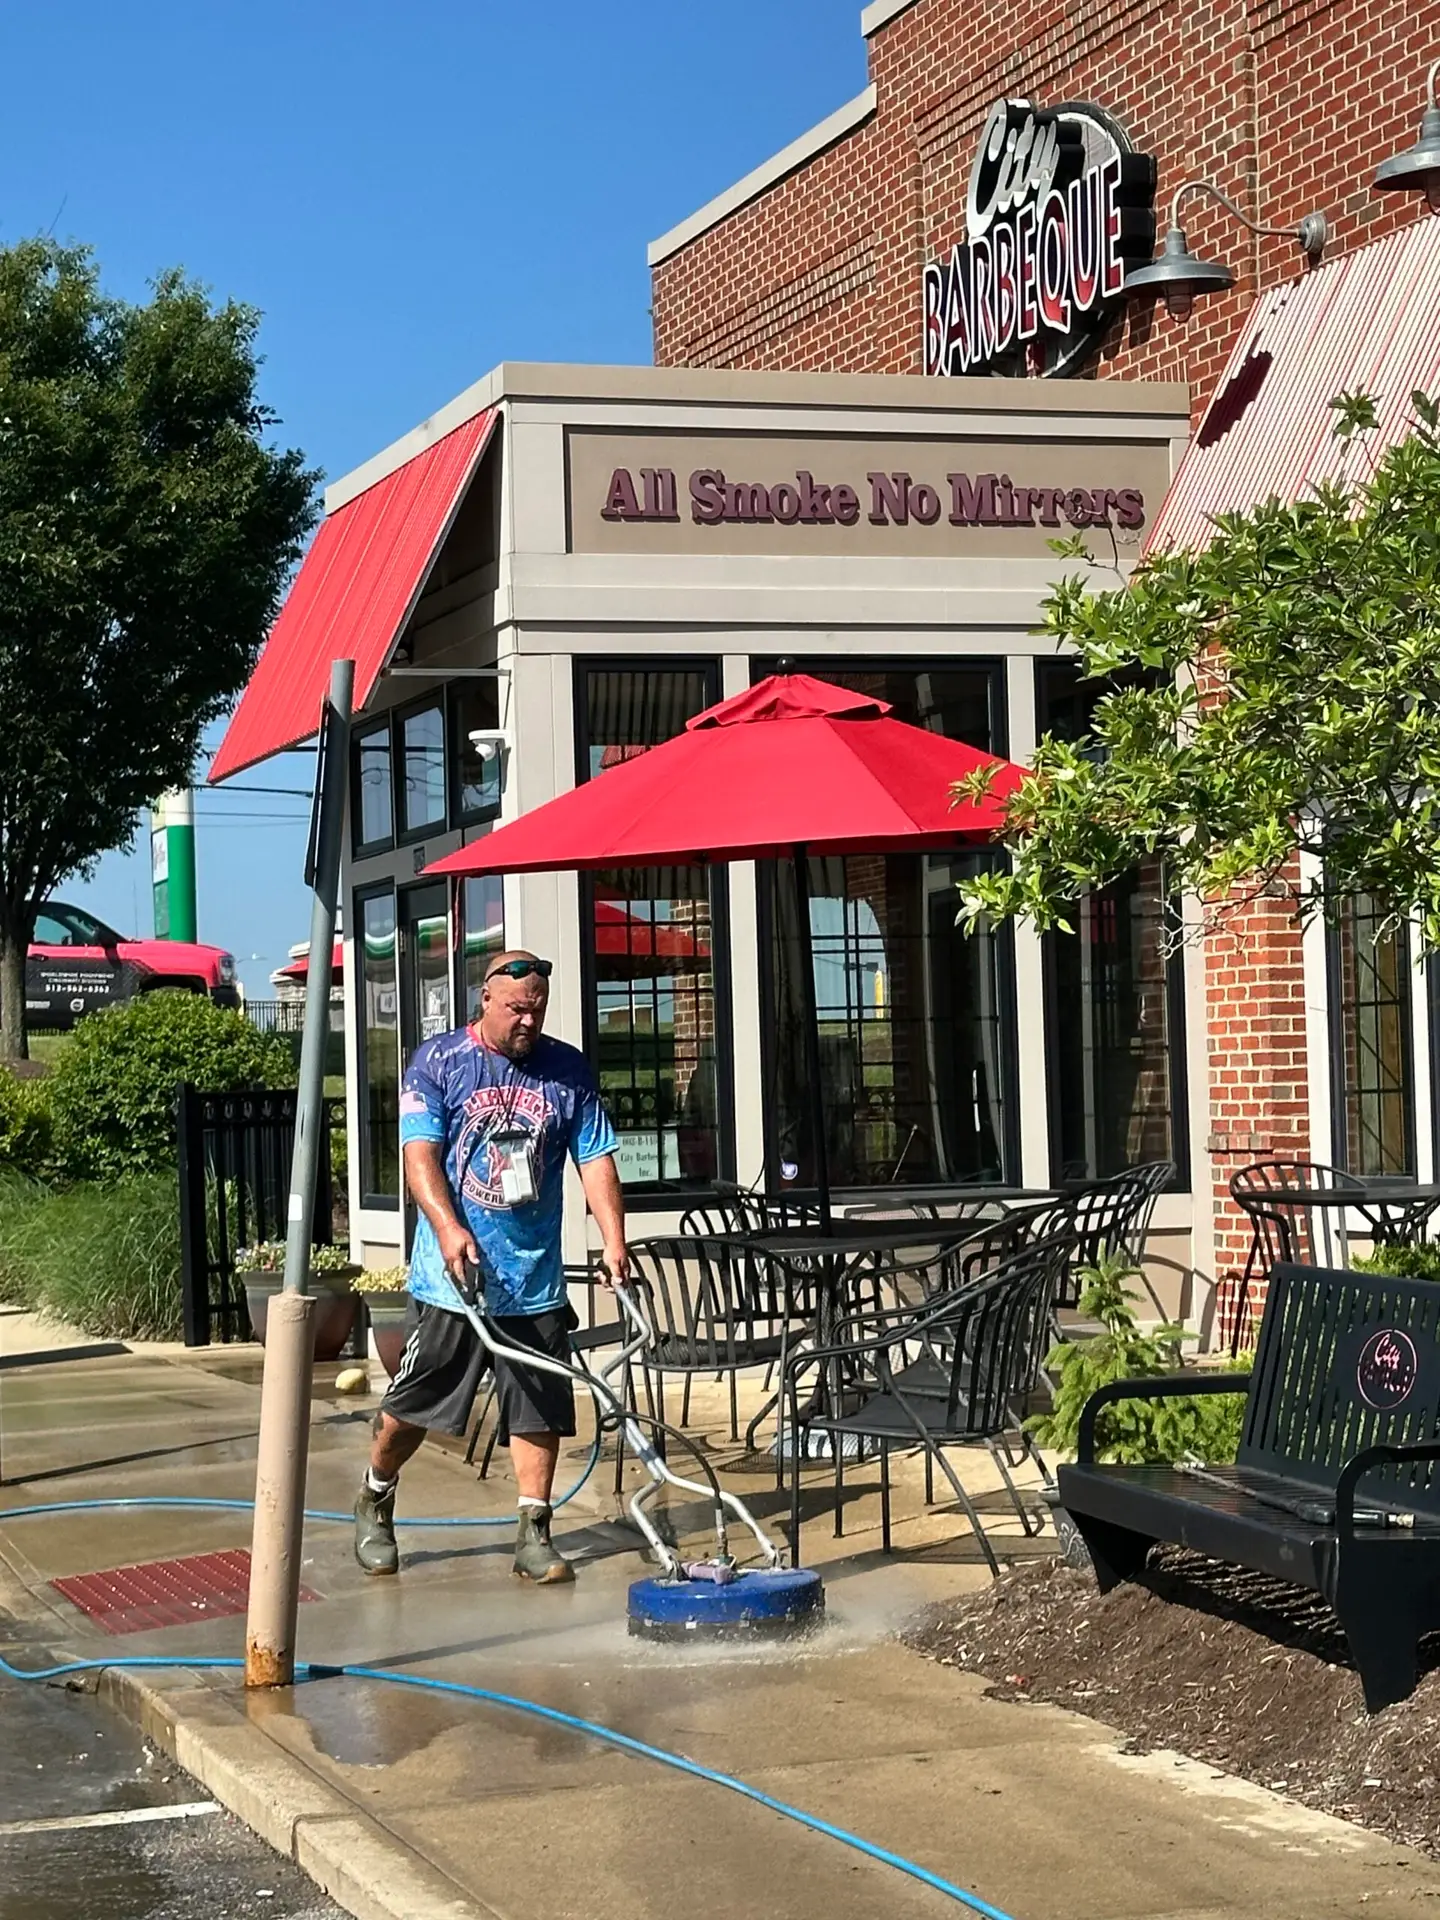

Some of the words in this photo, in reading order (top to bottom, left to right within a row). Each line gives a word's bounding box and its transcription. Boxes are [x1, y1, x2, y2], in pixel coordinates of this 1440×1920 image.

[967, 98, 1061, 237] City
[922, 151, 1125, 377] BARBEQUE
[601, 467, 681, 523] All
[689, 468, 860, 527] Smoke
[867, 471, 941, 526] No
[947, 472, 1146, 529] Mirrors
[1375, 1333, 1401, 1369] City
